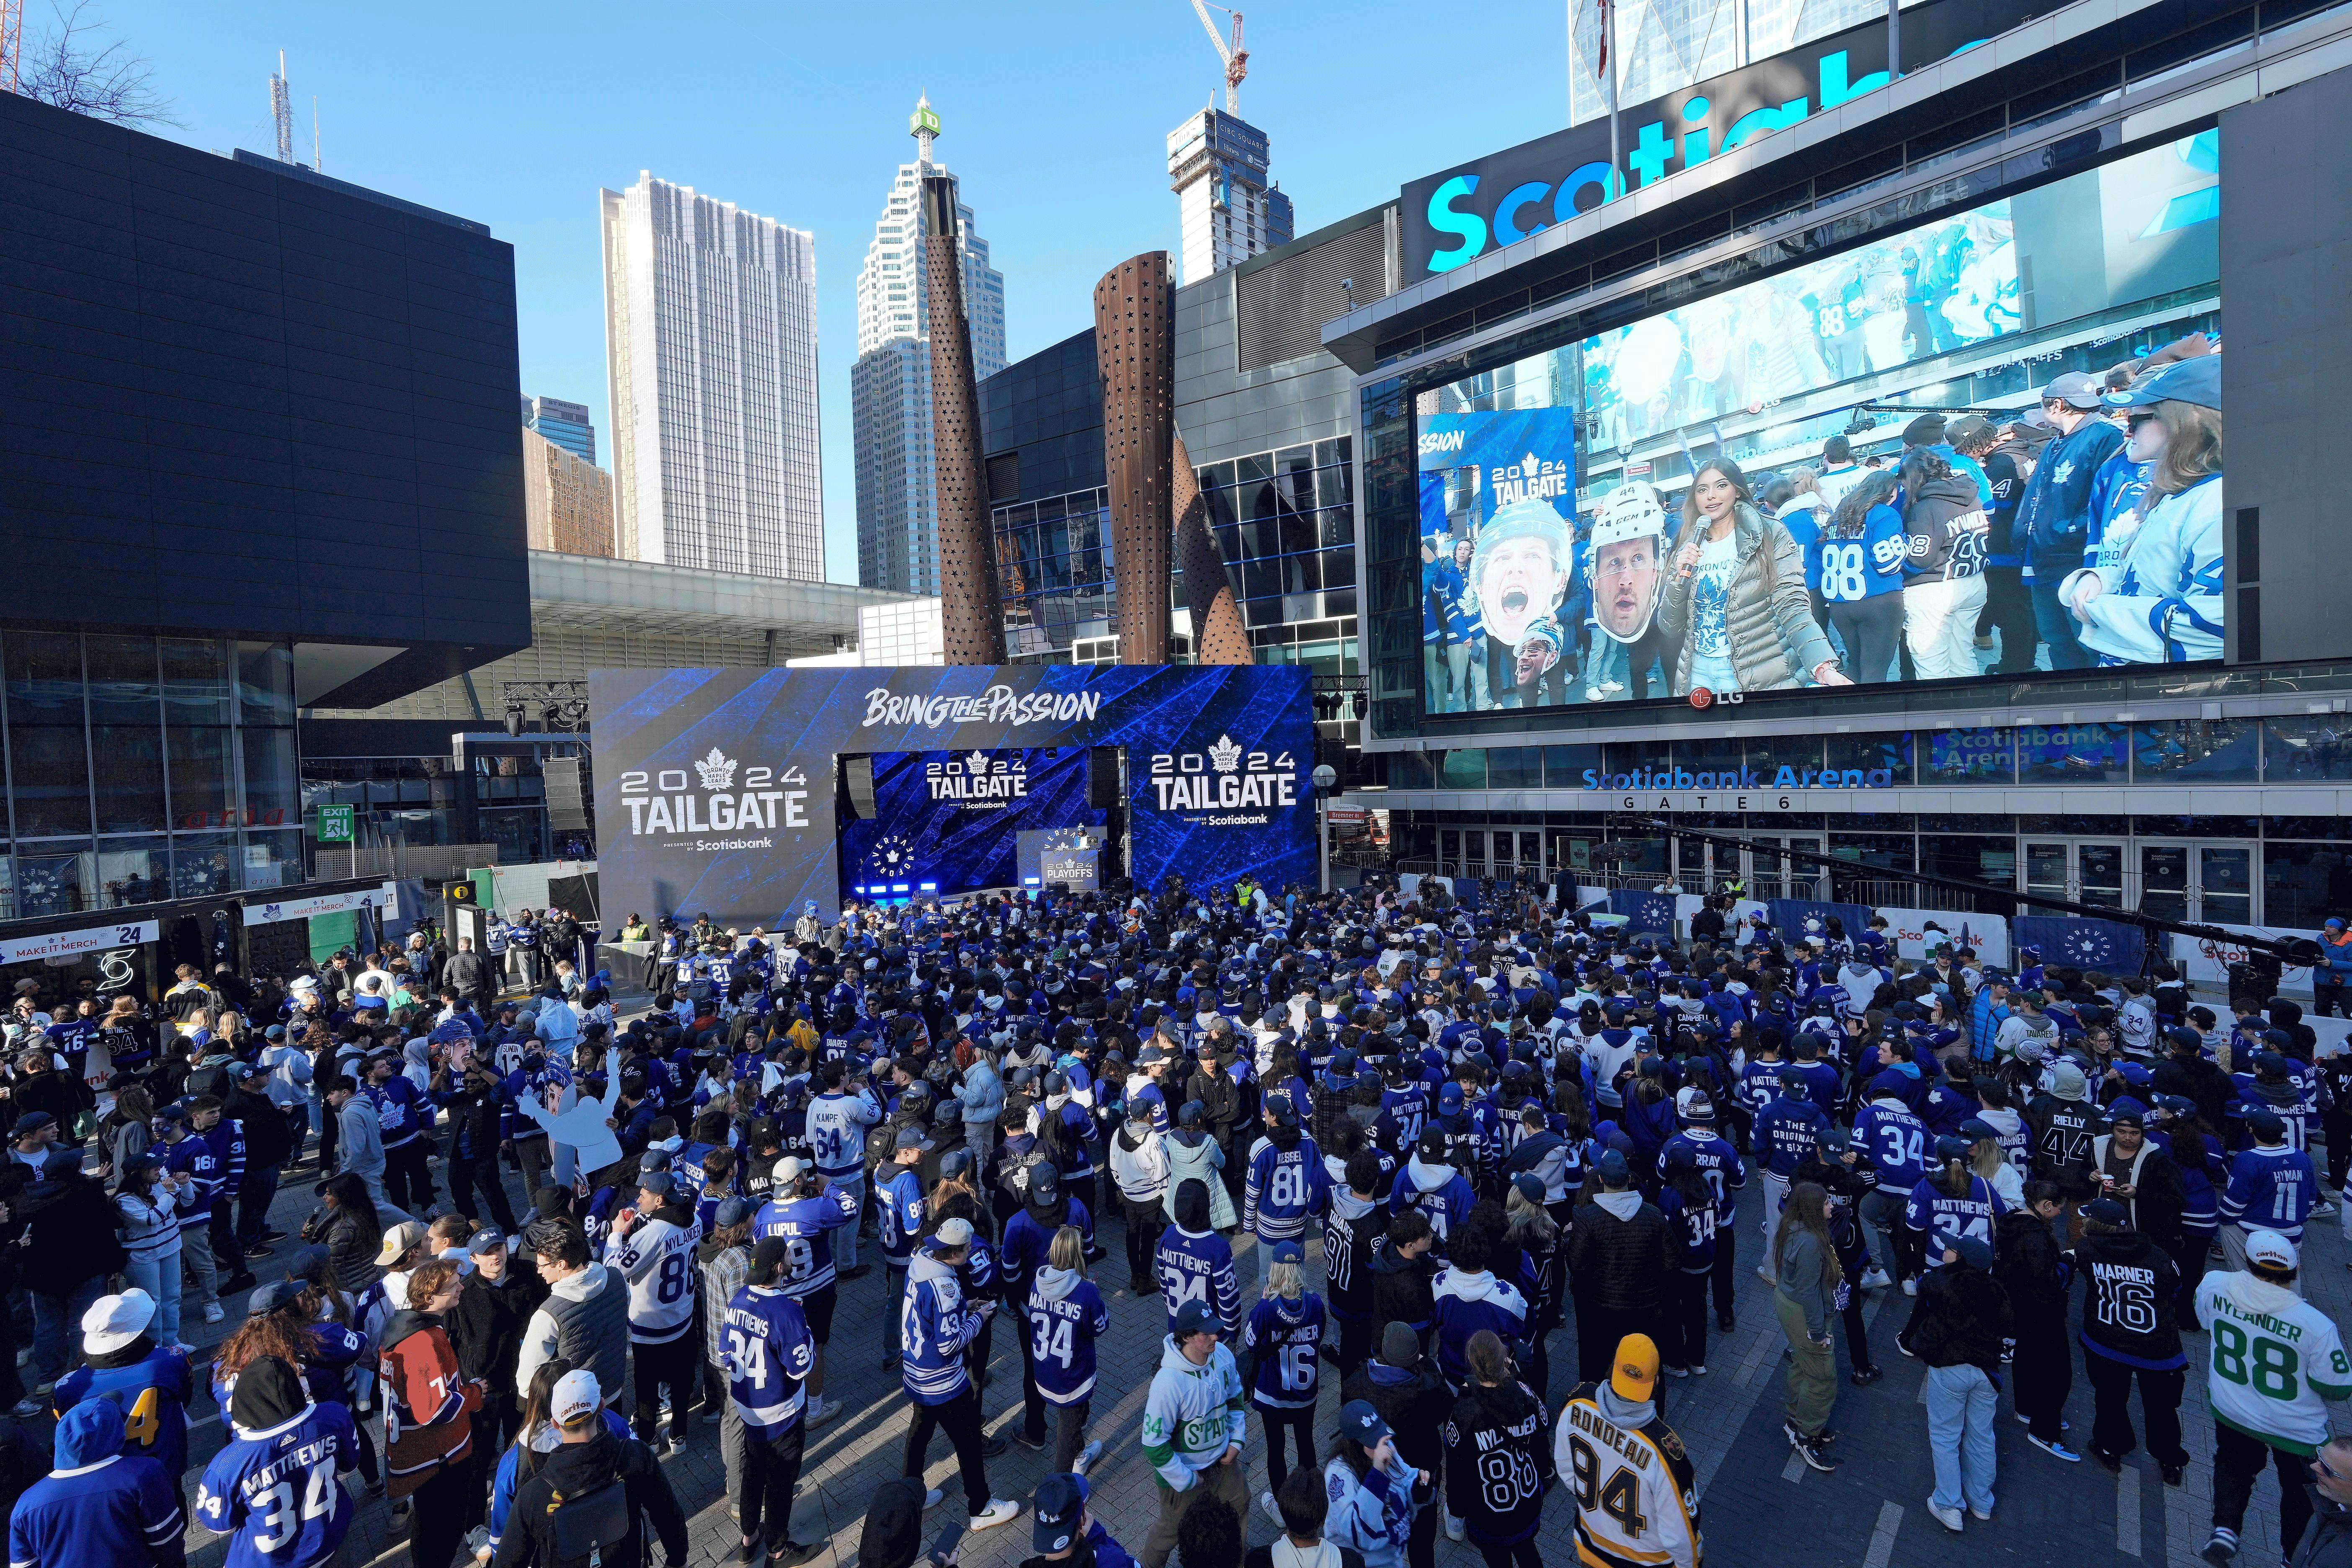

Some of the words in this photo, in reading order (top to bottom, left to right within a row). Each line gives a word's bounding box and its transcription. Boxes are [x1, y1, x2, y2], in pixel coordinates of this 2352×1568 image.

[1542, 460, 1566, 475] 24
[1492, 474, 1567, 505] TAILGATE
[1620, 486, 1635, 496] 44
[1616, 513, 1638, 525] CCM
[1872, 534, 1906, 563] 88
[1821, 544, 1867, 601] 88
[1717, 689, 1744, 704] LG
[1946, 727, 2109, 748] Scotiabank
[1945, 750, 2030, 765] Arena
[927, 775, 1027, 799] TAILGATE
[1582, 765, 1762, 790] Scotiabank
[1772, 765, 1893, 789] Arena
[1152, 774, 1296, 810] TAILGATE
[323, 808, 349, 817] EXIT
[622, 791, 809, 835] TAILGATE
[1624, 797, 1748, 810] GATE
[1779, 797, 1790, 810] 6
[186, 804, 284, 828] aria
[1209, 814, 1268, 826] Scotiabank
[696, 837, 772, 852] Scotiabank
[1047, 869, 1093, 878] PLAYOFFS
[487, 930, 500, 942] 17
[17, 947, 47, 957] MAKE
[62, 939, 97, 950] MERCH
[712, 965, 731, 982] 21
[292, 1020, 309, 1030] 34
[2128, 1014, 2144, 1027] 34
[108, 1036, 138, 1055] 34
[826, 1039, 847, 1048] TAVARES
[380, 1111, 402, 1122] TORONTO
[816, 1113, 838, 1124] KAMPF
[1151, 1100, 1165, 1117] 34
[1392, 1101, 1423, 1116] MATTHEWS
[2267, 1104, 2305, 1115] TAVARES
[1786, 1120, 1806, 1131] THE
[1875, 1111, 1922, 1129] MATTHEWS
[2053, 1114, 2085, 1128] RIELLY
[789, 1136, 807, 1149] 64
[815, 1127, 842, 1159] 64
[1773, 1130, 1816, 1144] ORIGINAL
[1995, 1133, 2026, 1146] MARNER
[2041, 1128, 2094, 1166] 44
[1277, 1150, 1303, 1164] KESSEL
[1786, 1144, 1803, 1153] SIX
[1881, 1125, 1924, 1171] 34
[998, 1157, 1022, 1174] MAPLE
[1023, 1150, 1045, 1166] LEAFS
[1271, 1165, 1307, 1207] 81
[2273, 1170, 2303, 1182] HYMAN
[909, 1199, 923, 1217] 88
[1933, 1199, 1990, 1217] MATTHEWS
[2273, 1183, 2298, 1221] 11
[767, 1221, 802, 1237] LUPUL
[1329, 1209, 1354, 1241] TAVARES
[1688, 1210, 1715, 1247] 34
[665, 1224, 701, 1253] NYLANDER
[619, 1245, 640, 1269] 88
[1162, 1247, 1211, 1274] MATTHEWS
[1326, 1227, 1352, 1291] 91
[2256, 1251, 2288, 1261] carlton
[658, 1246, 698, 1305] 88
[2092, 1262, 2154, 1284] MARNER
[746, 1294, 759, 1303] Reebok
[1164, 1266, 1209, 1318] 34
[1029, 1292, 1082, 1320] MATTHEWS
[2094, 1277, 2156, 1333] 16
[725, 1307, 769, 1338] MATTHEWS
[940, 1315, 960, 1337] 43
[2213, 1294, 2303, 1343] NYLANDER
[1030, 1313, 1073, 1369] 34
[727, 1328, 767, 1390] 34
[1279, 1344, 1315, 1391] 16
[2213, 1318, 2298, 1400] 88
[560, 1401, 591, 1418] carlton
[1143, 1413, 1163, 1437] 34
[1570, 1403, 1653, 1470] RONDEAU
[242, 1435, 336, 1496] MATTHEWS
[1569, 1433, 1647, 1539] 94
[196, 1483, 221, 1519] 34
[251, 1455, 337, 1553] 34
